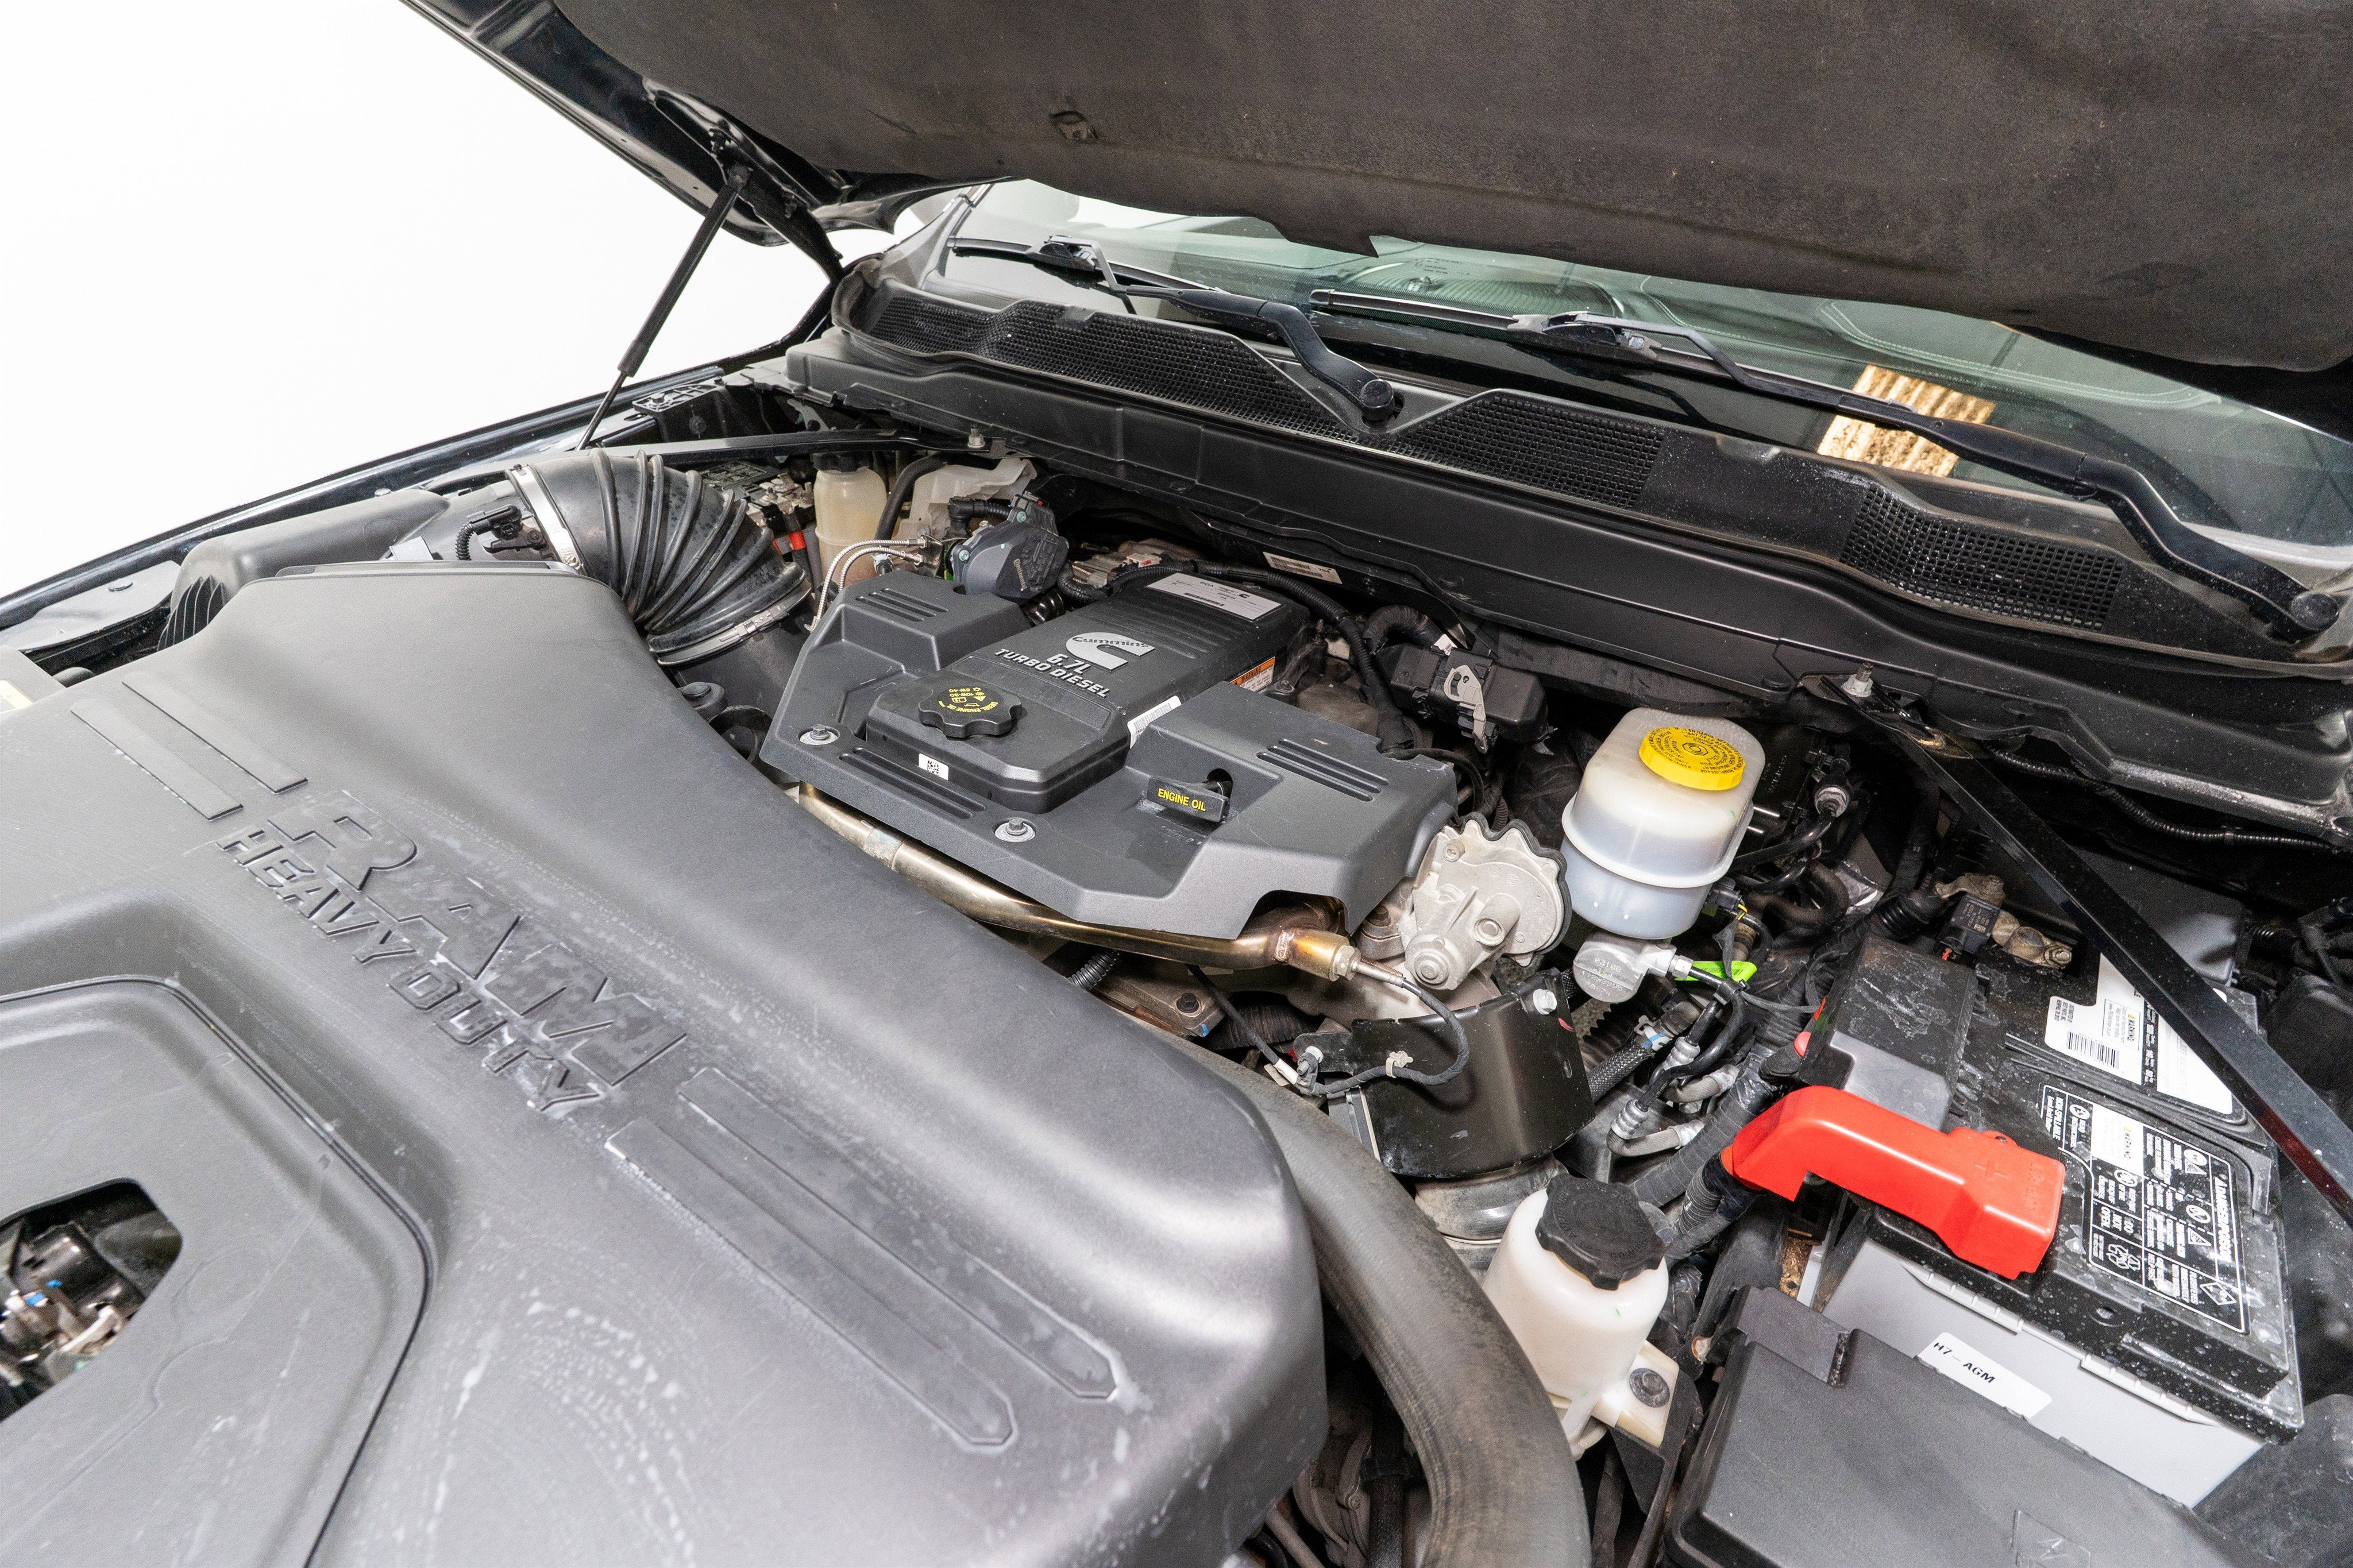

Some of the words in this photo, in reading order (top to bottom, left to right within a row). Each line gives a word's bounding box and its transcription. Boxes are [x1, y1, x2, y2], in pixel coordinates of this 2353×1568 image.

[1013, 558, 1027, 590] Continental
[1072, 636, 1150, 648] Cummins
[995, 648, 1052, 672] TURBO
[1049, 668, 1110, 698] DIESEL
[1047, 654, 1091, 675] 6.7L
[1241, 666, 1262, 682] WARNING
[980, 701, 998, 711] DIESEL
[1158, 788, 1189, 806] ENGINE
[1191, 800, 1206, 812] OIL
[267, 789, 688, 1086] RAM
[216, 825, 415, 965] HEAVY
[387, 967, 605, 1113] DUTY
[2112, 1211, 2122, 1232] NOT
[2123, 1219, 2134, 1234] DO
[1933, 1342, 1952, 1354] H7
[1963, 1362, 1995, 1383] AGM
